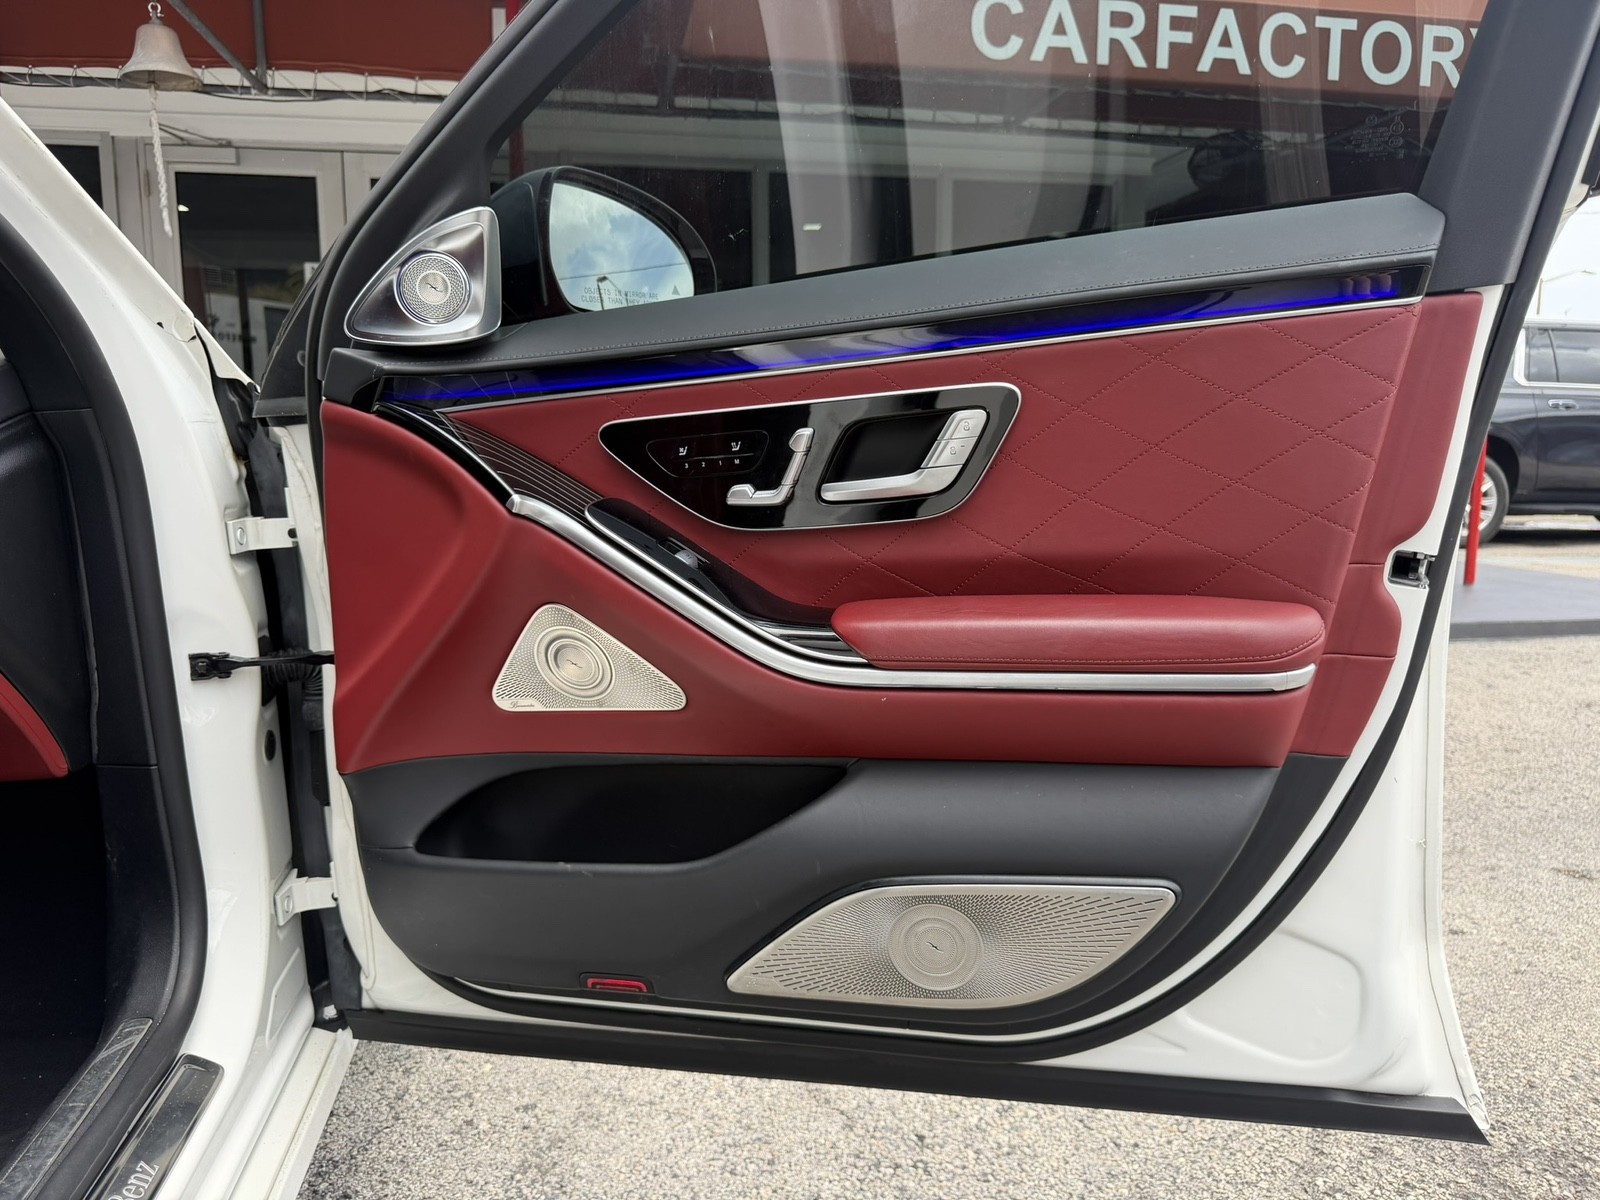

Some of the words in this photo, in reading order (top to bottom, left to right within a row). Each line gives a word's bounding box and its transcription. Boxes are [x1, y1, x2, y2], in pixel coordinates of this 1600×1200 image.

[970, 0, 1479, 89] CARFACTOR
[614, 289, 622, 297] IN
[625, 290, 646, 298] MIRROR
[581, 295, 603, 304] CLOSE
